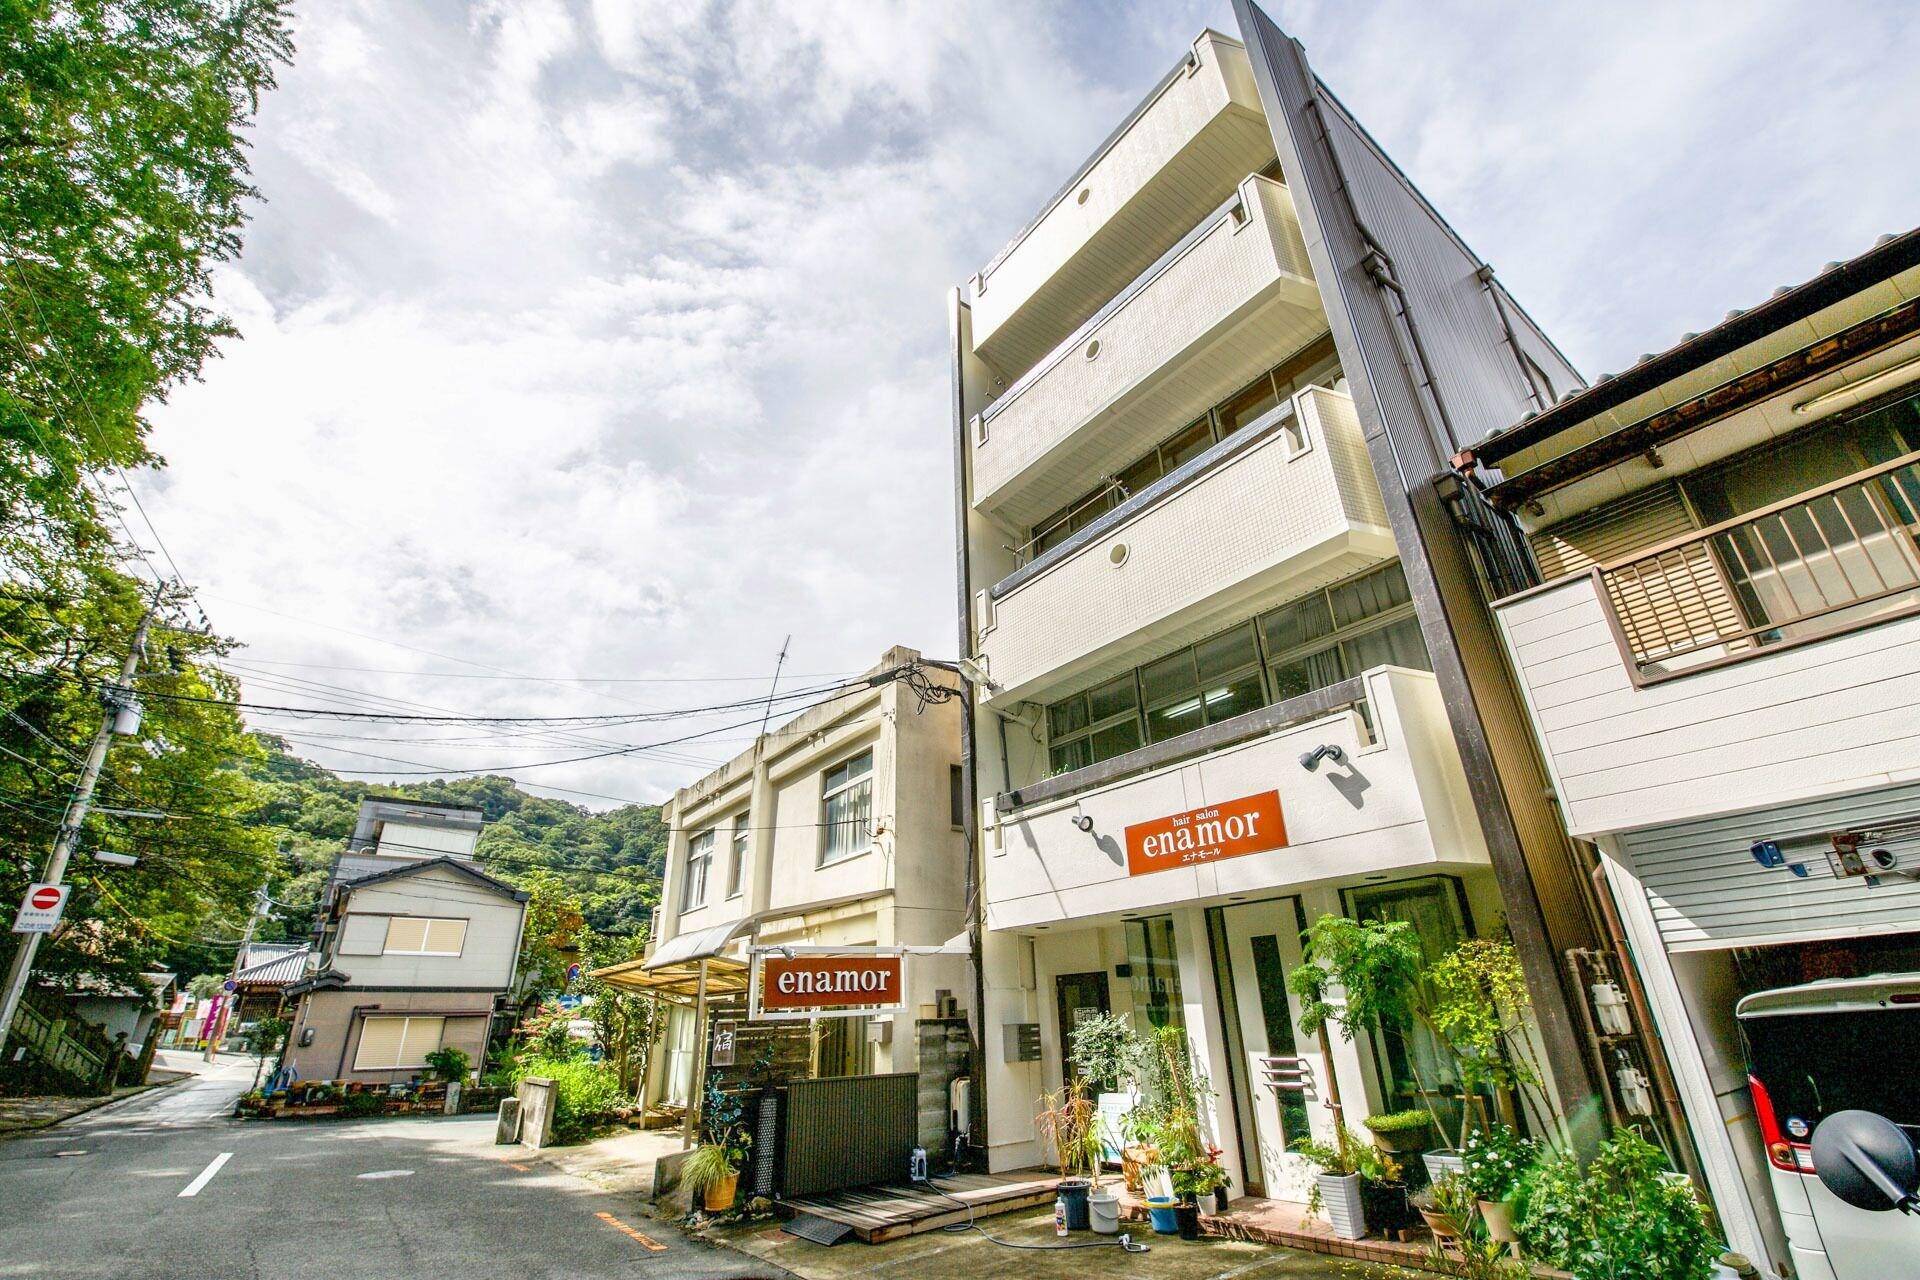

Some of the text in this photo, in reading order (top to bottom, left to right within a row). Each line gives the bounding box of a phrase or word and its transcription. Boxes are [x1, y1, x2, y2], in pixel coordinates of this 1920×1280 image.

[1172, 809, 1220, 827] hair salon
[1143, 811, 1260, 857] enamor
[1182, 847, 1221, 862] エナモール
[778, 970, 891, 993] enamor
[714, 1029, 733, 1052] 宿
